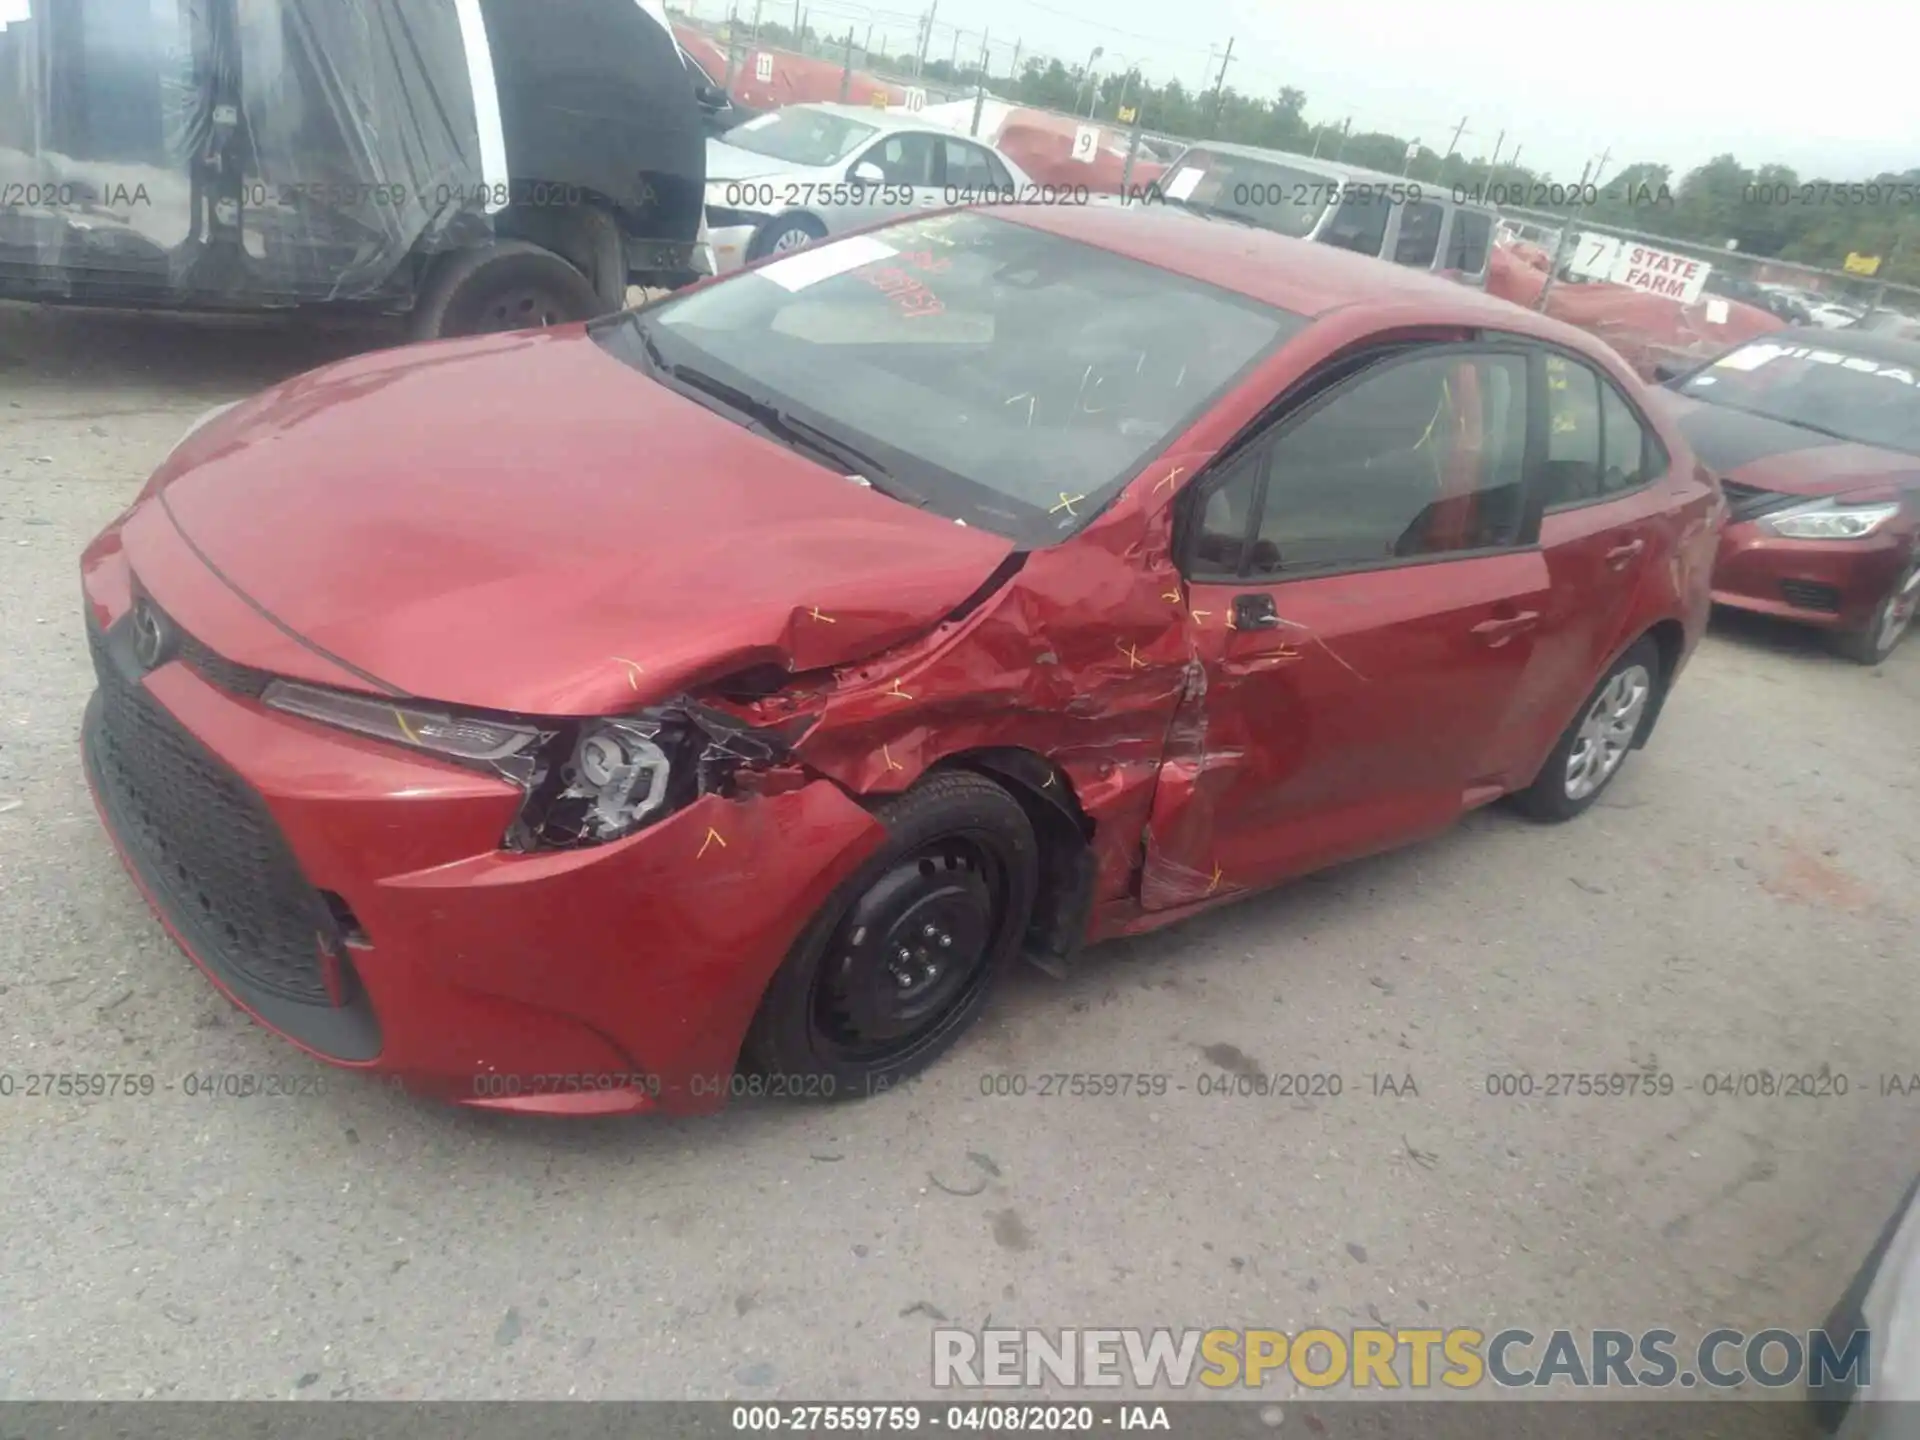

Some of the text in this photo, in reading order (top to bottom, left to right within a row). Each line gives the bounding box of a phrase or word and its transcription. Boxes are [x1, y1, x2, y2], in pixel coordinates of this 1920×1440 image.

[907, 88, 923, 112] 10
[1081, 133, 1092, 153] 9
[1587, 241, 1606, 267] 7
[1629, 247, 1700, 281] STATE
[1625, 268, 1687, 298] FARM
